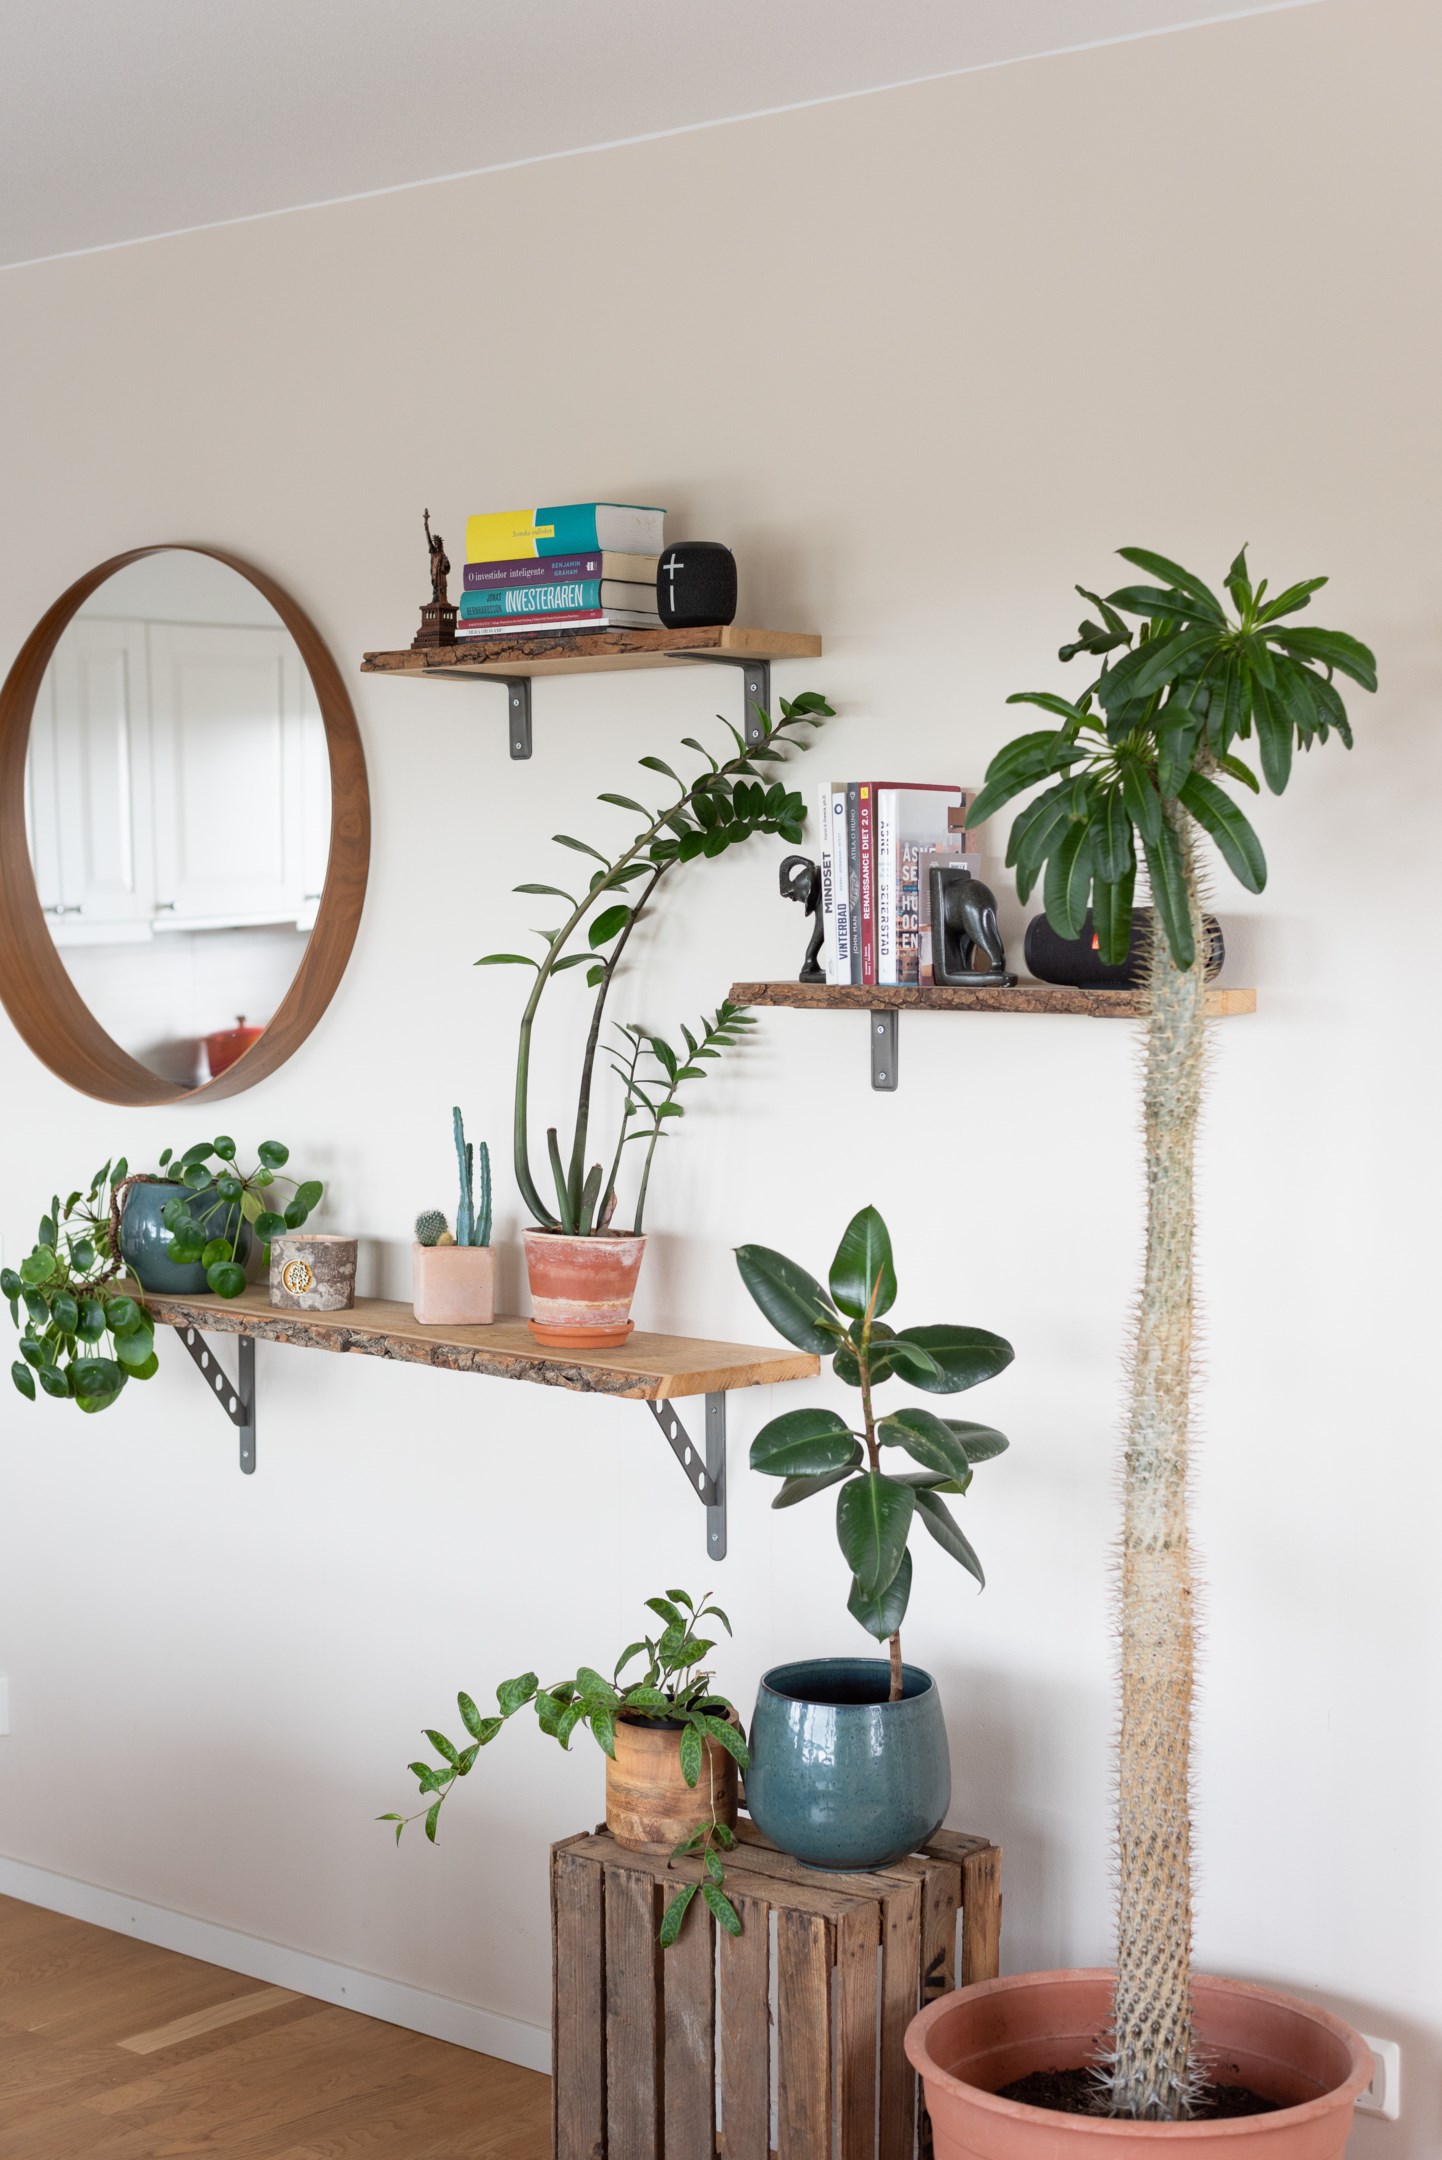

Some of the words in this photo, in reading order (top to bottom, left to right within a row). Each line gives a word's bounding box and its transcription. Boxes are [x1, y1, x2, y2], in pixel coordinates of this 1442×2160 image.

[468, 573, 475, 582] O
[476, 570, 507, 580] investidor
[510, 568, 544, 578] inteligente
[487, 593, 503, 602] JONAS
[505, 584, 583, 613] INVESTERAREN
[822, 852, 832, 914] MINDSET
[862, 853, 870, 920] RENAISSANCE
[880, 884, 889, 955] SEIERSTAD
